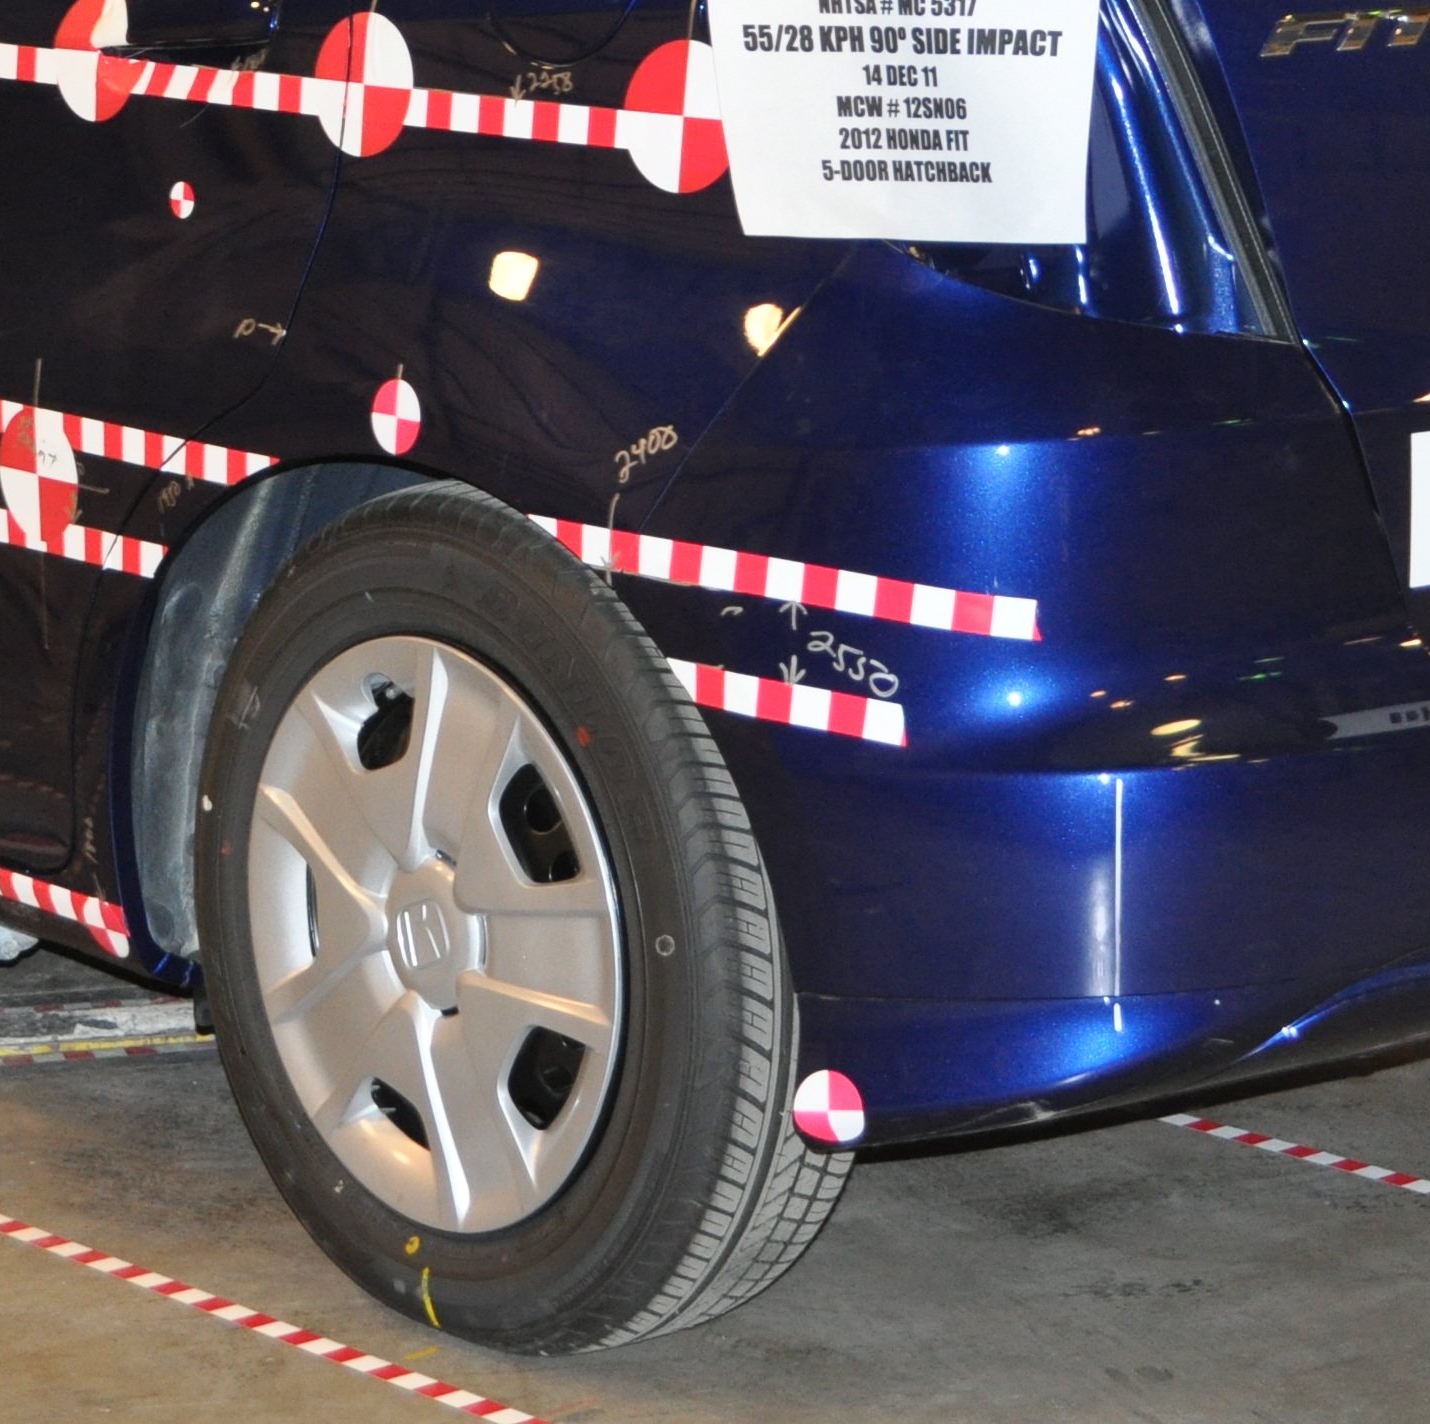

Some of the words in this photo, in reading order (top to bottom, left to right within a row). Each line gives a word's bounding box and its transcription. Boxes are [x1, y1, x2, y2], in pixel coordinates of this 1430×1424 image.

[742, 24, 814, 53] 55/28
[819, 25, 865, 53] KPH
[911, 27, 961, 55] SIDE
[967, 28, 1063, 57] IMPACT
[861, 64, 882, 86] 14
[886, 65, 919, 87] DEC
[921, 66, 938, 88] 11
[836, 95, 883, 118] MCW
[887, 99, 901, 118] #
[903, 96, 967, 120] 12SN06
[838, 127, 883, 150] 2012
[886, 128, 944, 151] HONDA
[946, 129, 970, 152] FIT
[821, 159, 890, 182] 5-DOOR
[892, 160, 993, 184] HATCHBACK
[807, 630, 899, 699] 2550
